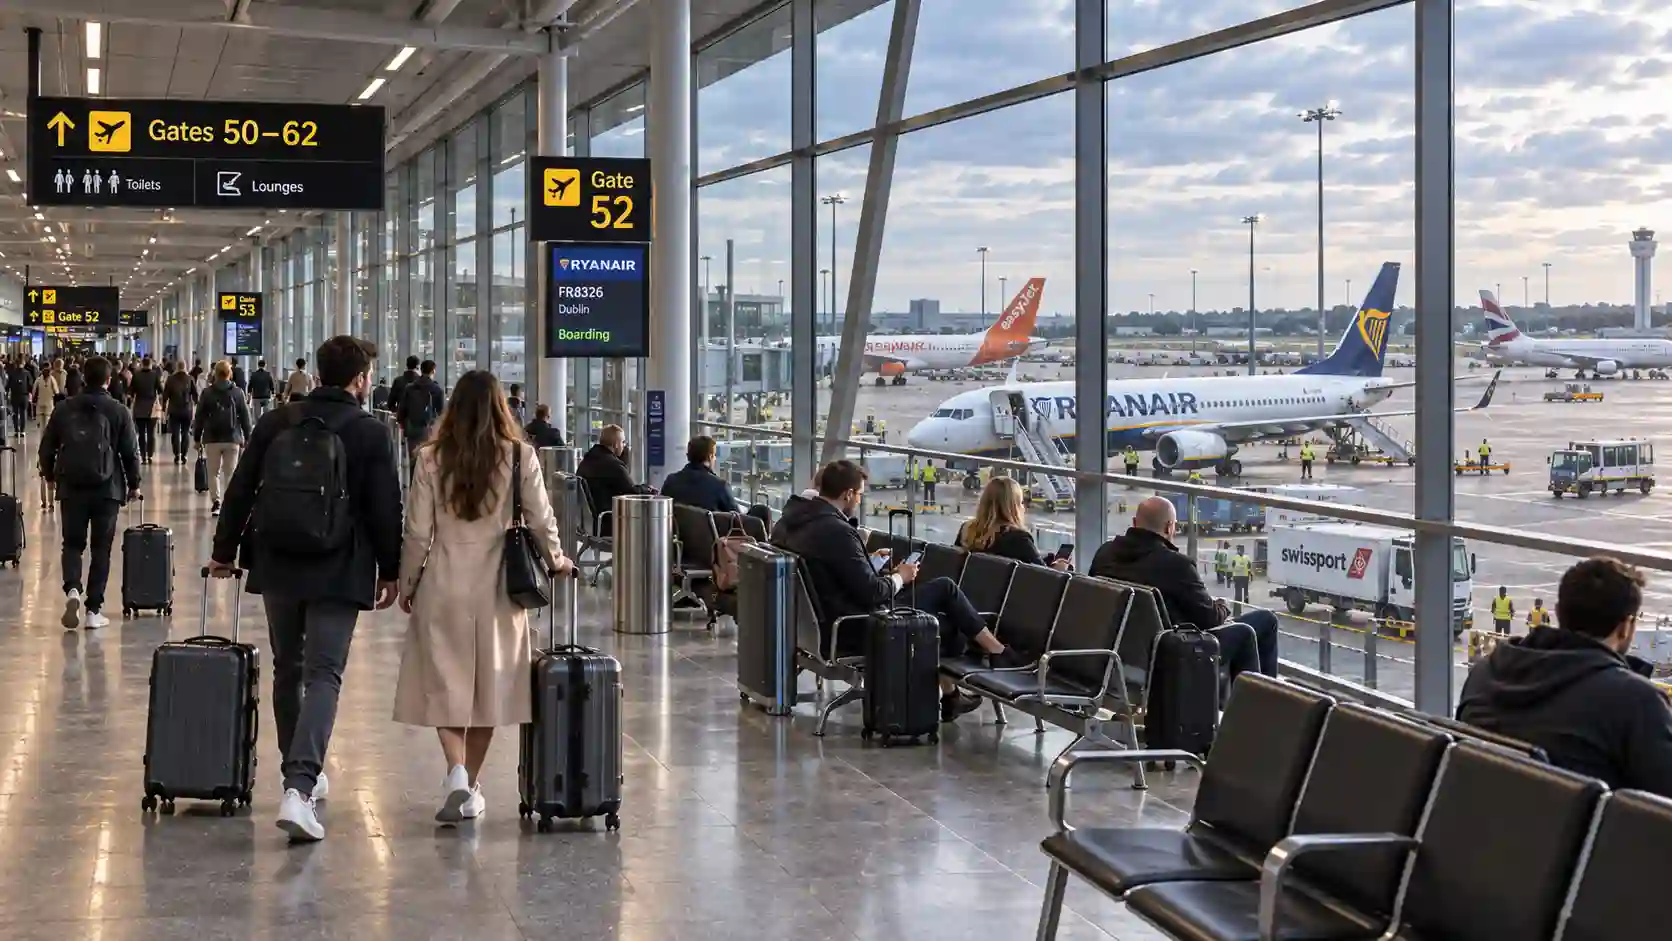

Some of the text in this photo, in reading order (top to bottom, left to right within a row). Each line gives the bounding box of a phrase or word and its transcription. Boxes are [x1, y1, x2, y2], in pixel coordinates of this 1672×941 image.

[148, 119, 214, 143] Gates
[125, 178, 162, 191] Toilets
[591, 170, 634, 189] Gate
[251, 180, 304, 196] Lounges
[590, 195, 634, 229] 52
[571, 259, 636, 271] RYANAIR
[558, 286, 604, 299] FR8326
[58, 311, 100, 323] Gate 52
[239, 303, 256, 317] 53
[558, 303, 590, 315] Dublin
[558, 327, 610, 343] Boarding
[1054, 392, 1199, 420] RANAIR
[1281, 543, 1347, 573] swissport
